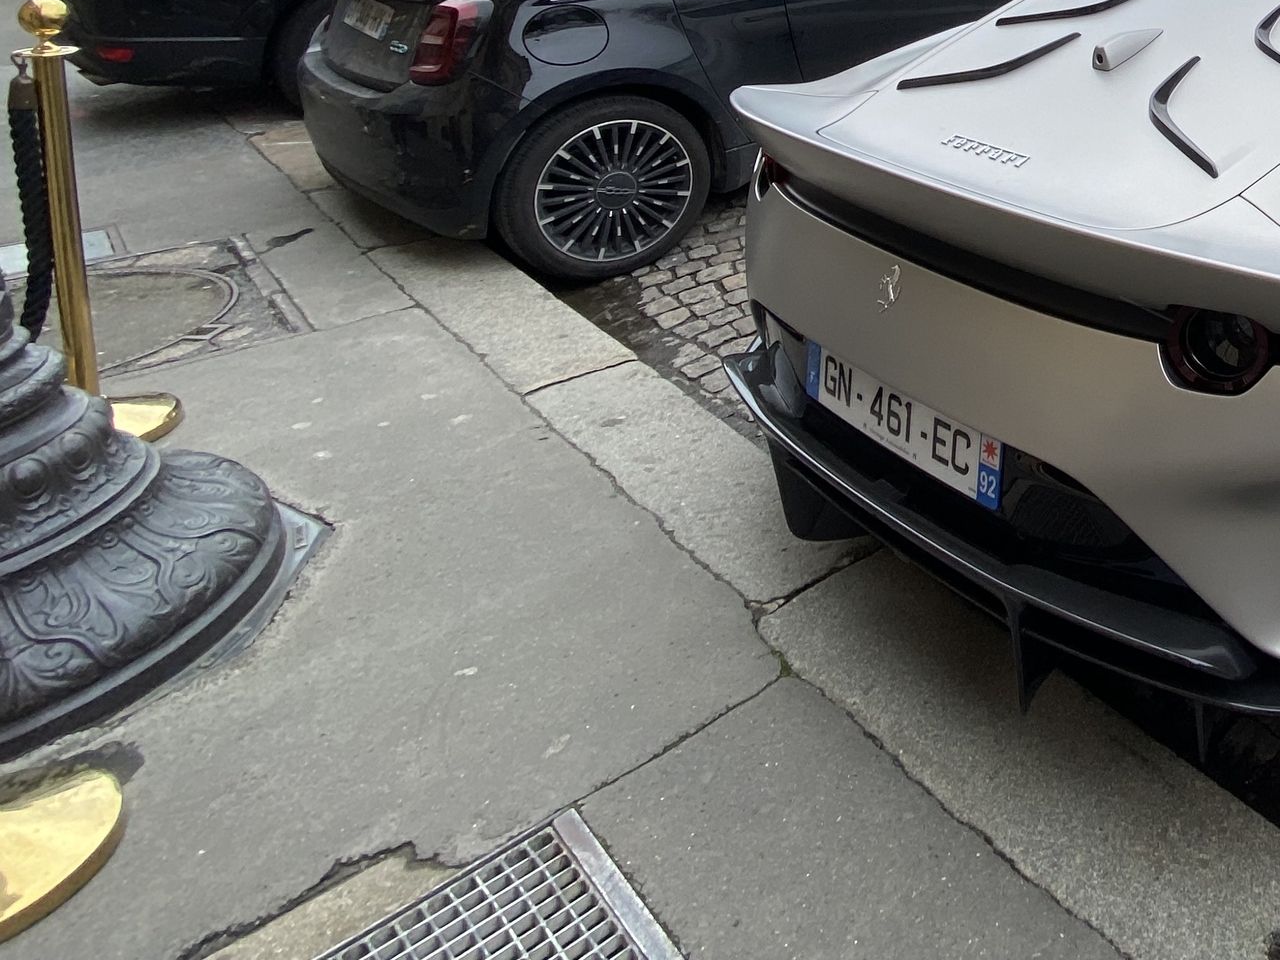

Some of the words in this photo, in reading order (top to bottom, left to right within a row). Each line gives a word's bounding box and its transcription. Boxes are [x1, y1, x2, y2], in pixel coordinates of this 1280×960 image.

[941, 134, 1031, 168] Ferrari
[824, 355, 971, 476] GN-461-EC
[979, 470, 996, 499] 92
